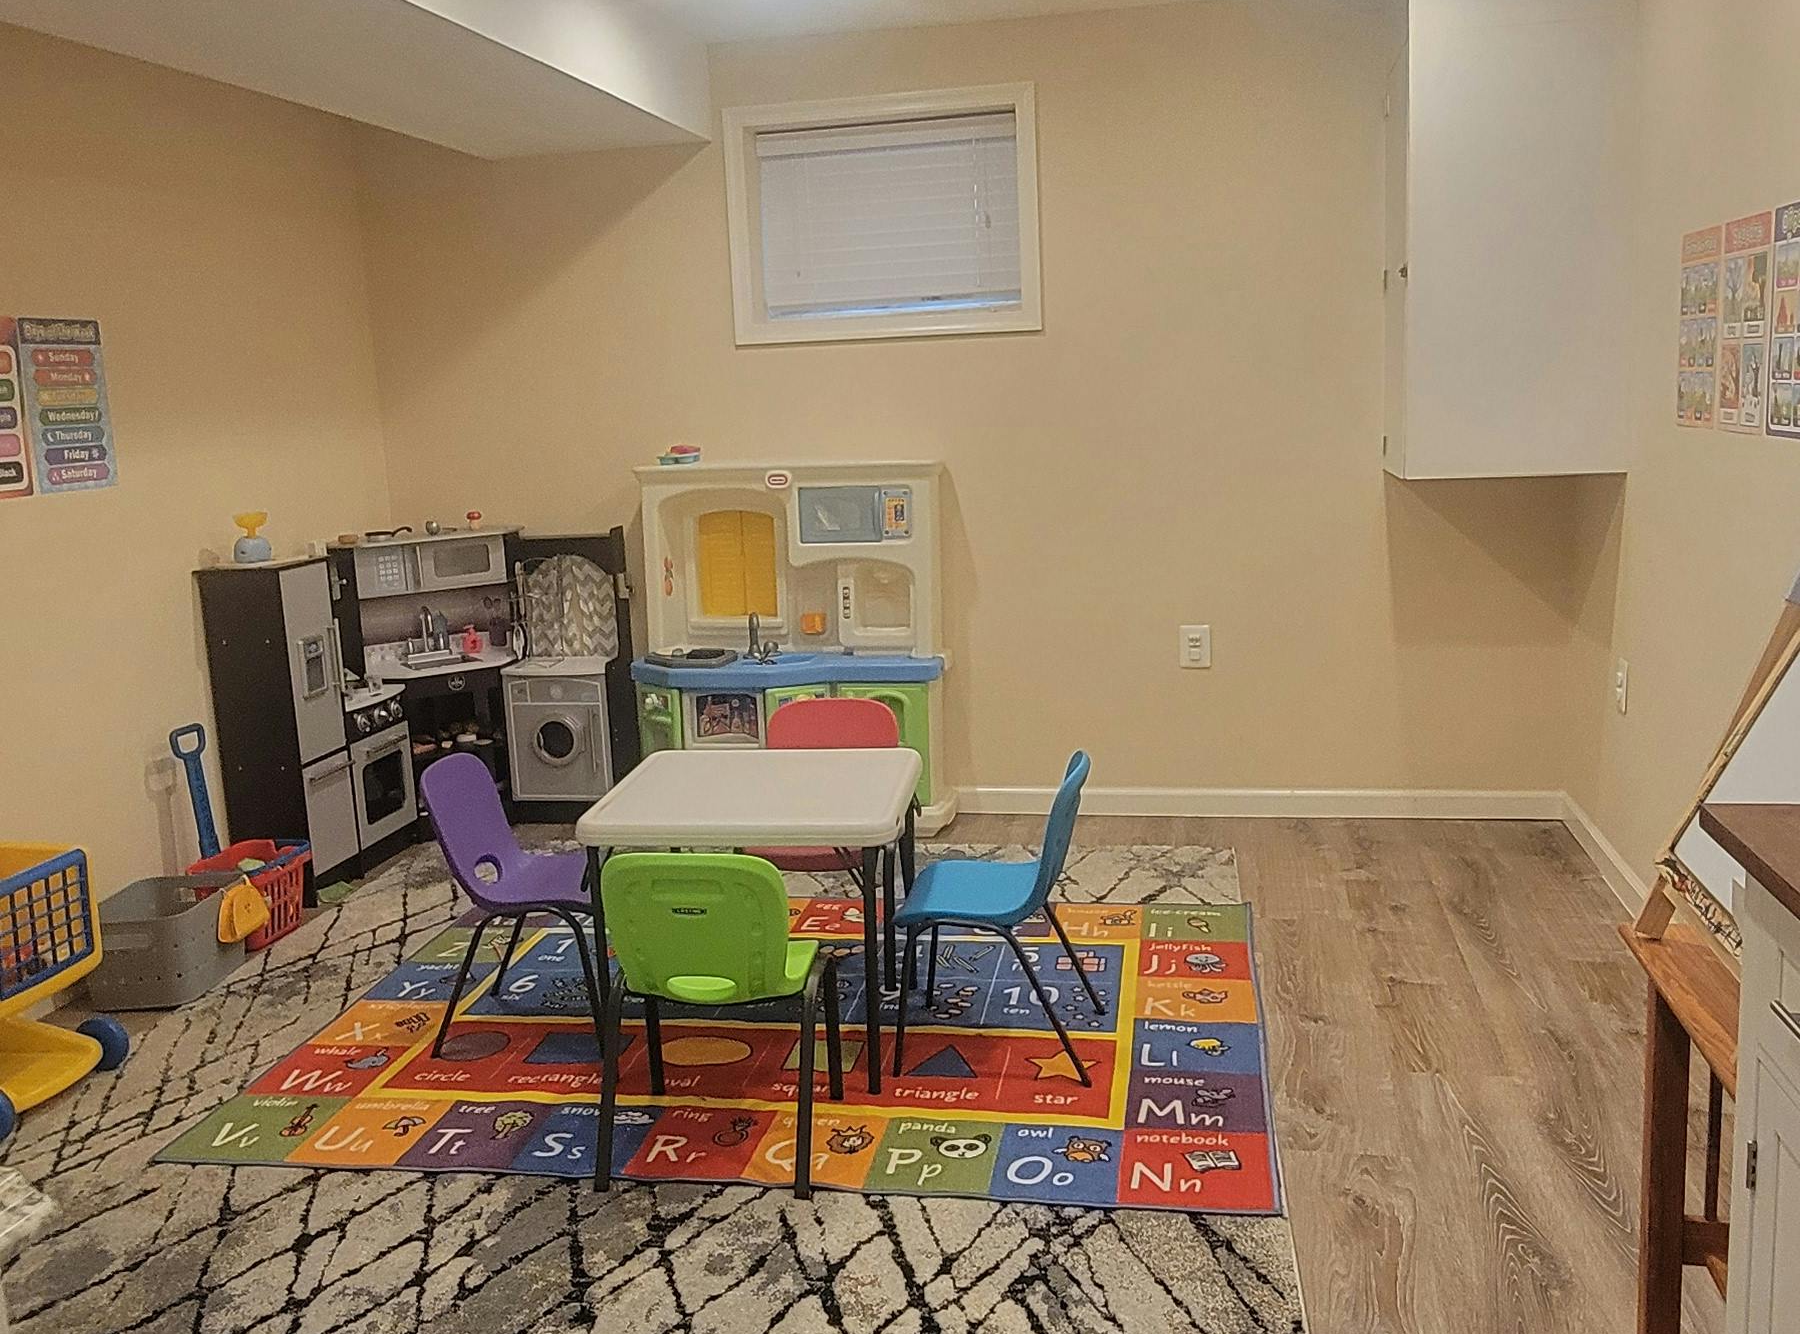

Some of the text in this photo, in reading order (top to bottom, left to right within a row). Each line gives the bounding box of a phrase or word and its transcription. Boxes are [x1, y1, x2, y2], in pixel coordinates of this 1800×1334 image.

[48, 351, 79, 364] Sunday
[50, 372, 82, 384] Monday
[47, 410, 93, 422] Wednesday
[55, 430, 92, 442] Thursday
[64, 449, 90, 461] Friday
[61, 467, 98, 480] Saturday
[1060, 921, 1109, 938] Hh
[556, 938, 575, 955] 1
[537, 954, 565, 962] one
[1015, 946, 1040, 963] 5
[508, 974, 539, 993] 6
[1003, 986, 1060, 1006] 10
[1002, 1006, 1031, 1016] ten
[1143, 997, 1196, 1017] Kk
[1143, 1021, 1198, 1034] lemon
[313, 1045, 362, 1057] whale
[413, 1069, 472, 1083] circle
[507, 1072, 603, 1088] rectangle
[1143, 1075, 1205, 1087] mouse
[771, 1081, 831, 1098] sqar
[894, 1086, 980, 1103] triangle
[252, 1096, 300, 1108] violin
[354, 1100, 431, 1112] umbrella
[1033, 1093, 1080, 1106] star
[458, 1103, 498, 1115] tree
[672, 1108, 714, 1123] ring
[782, 1115, 841, 1129] qen
[898, 1120, 957, 1135] panda
[1017, 1127, 1054, 1139] owl
[1135, 1132, 1230, 1147] notebook
